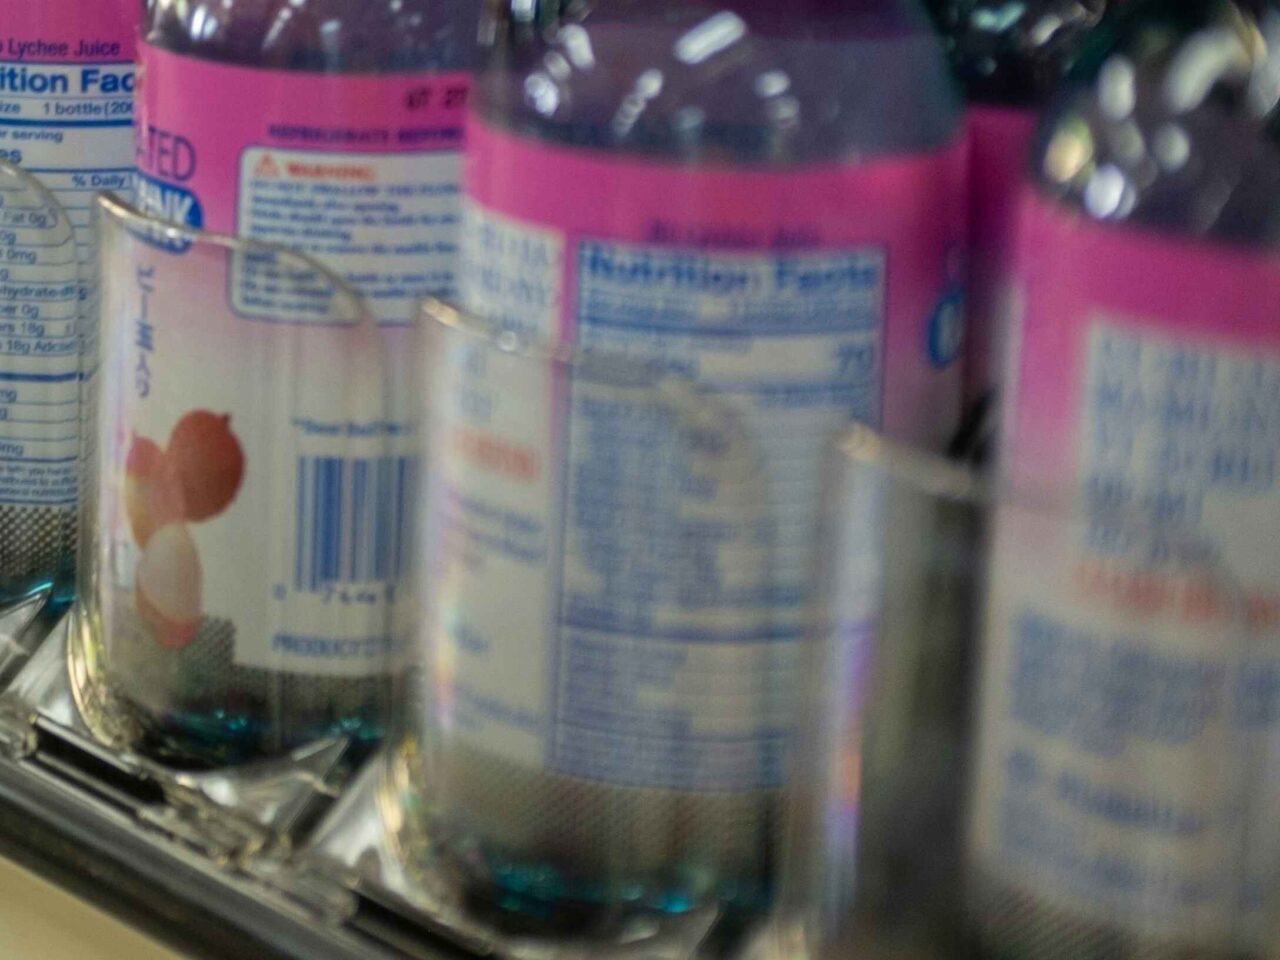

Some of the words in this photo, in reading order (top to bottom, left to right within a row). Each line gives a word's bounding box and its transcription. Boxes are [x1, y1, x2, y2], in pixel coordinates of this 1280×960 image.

[8, 38, 68, 60] Lychee
[74, 40, 121, 57] Juice
[11, 128, 65, 144] serving
[90, 171, 127, 189] Daily
[3, 210, 25, 224] Fat
